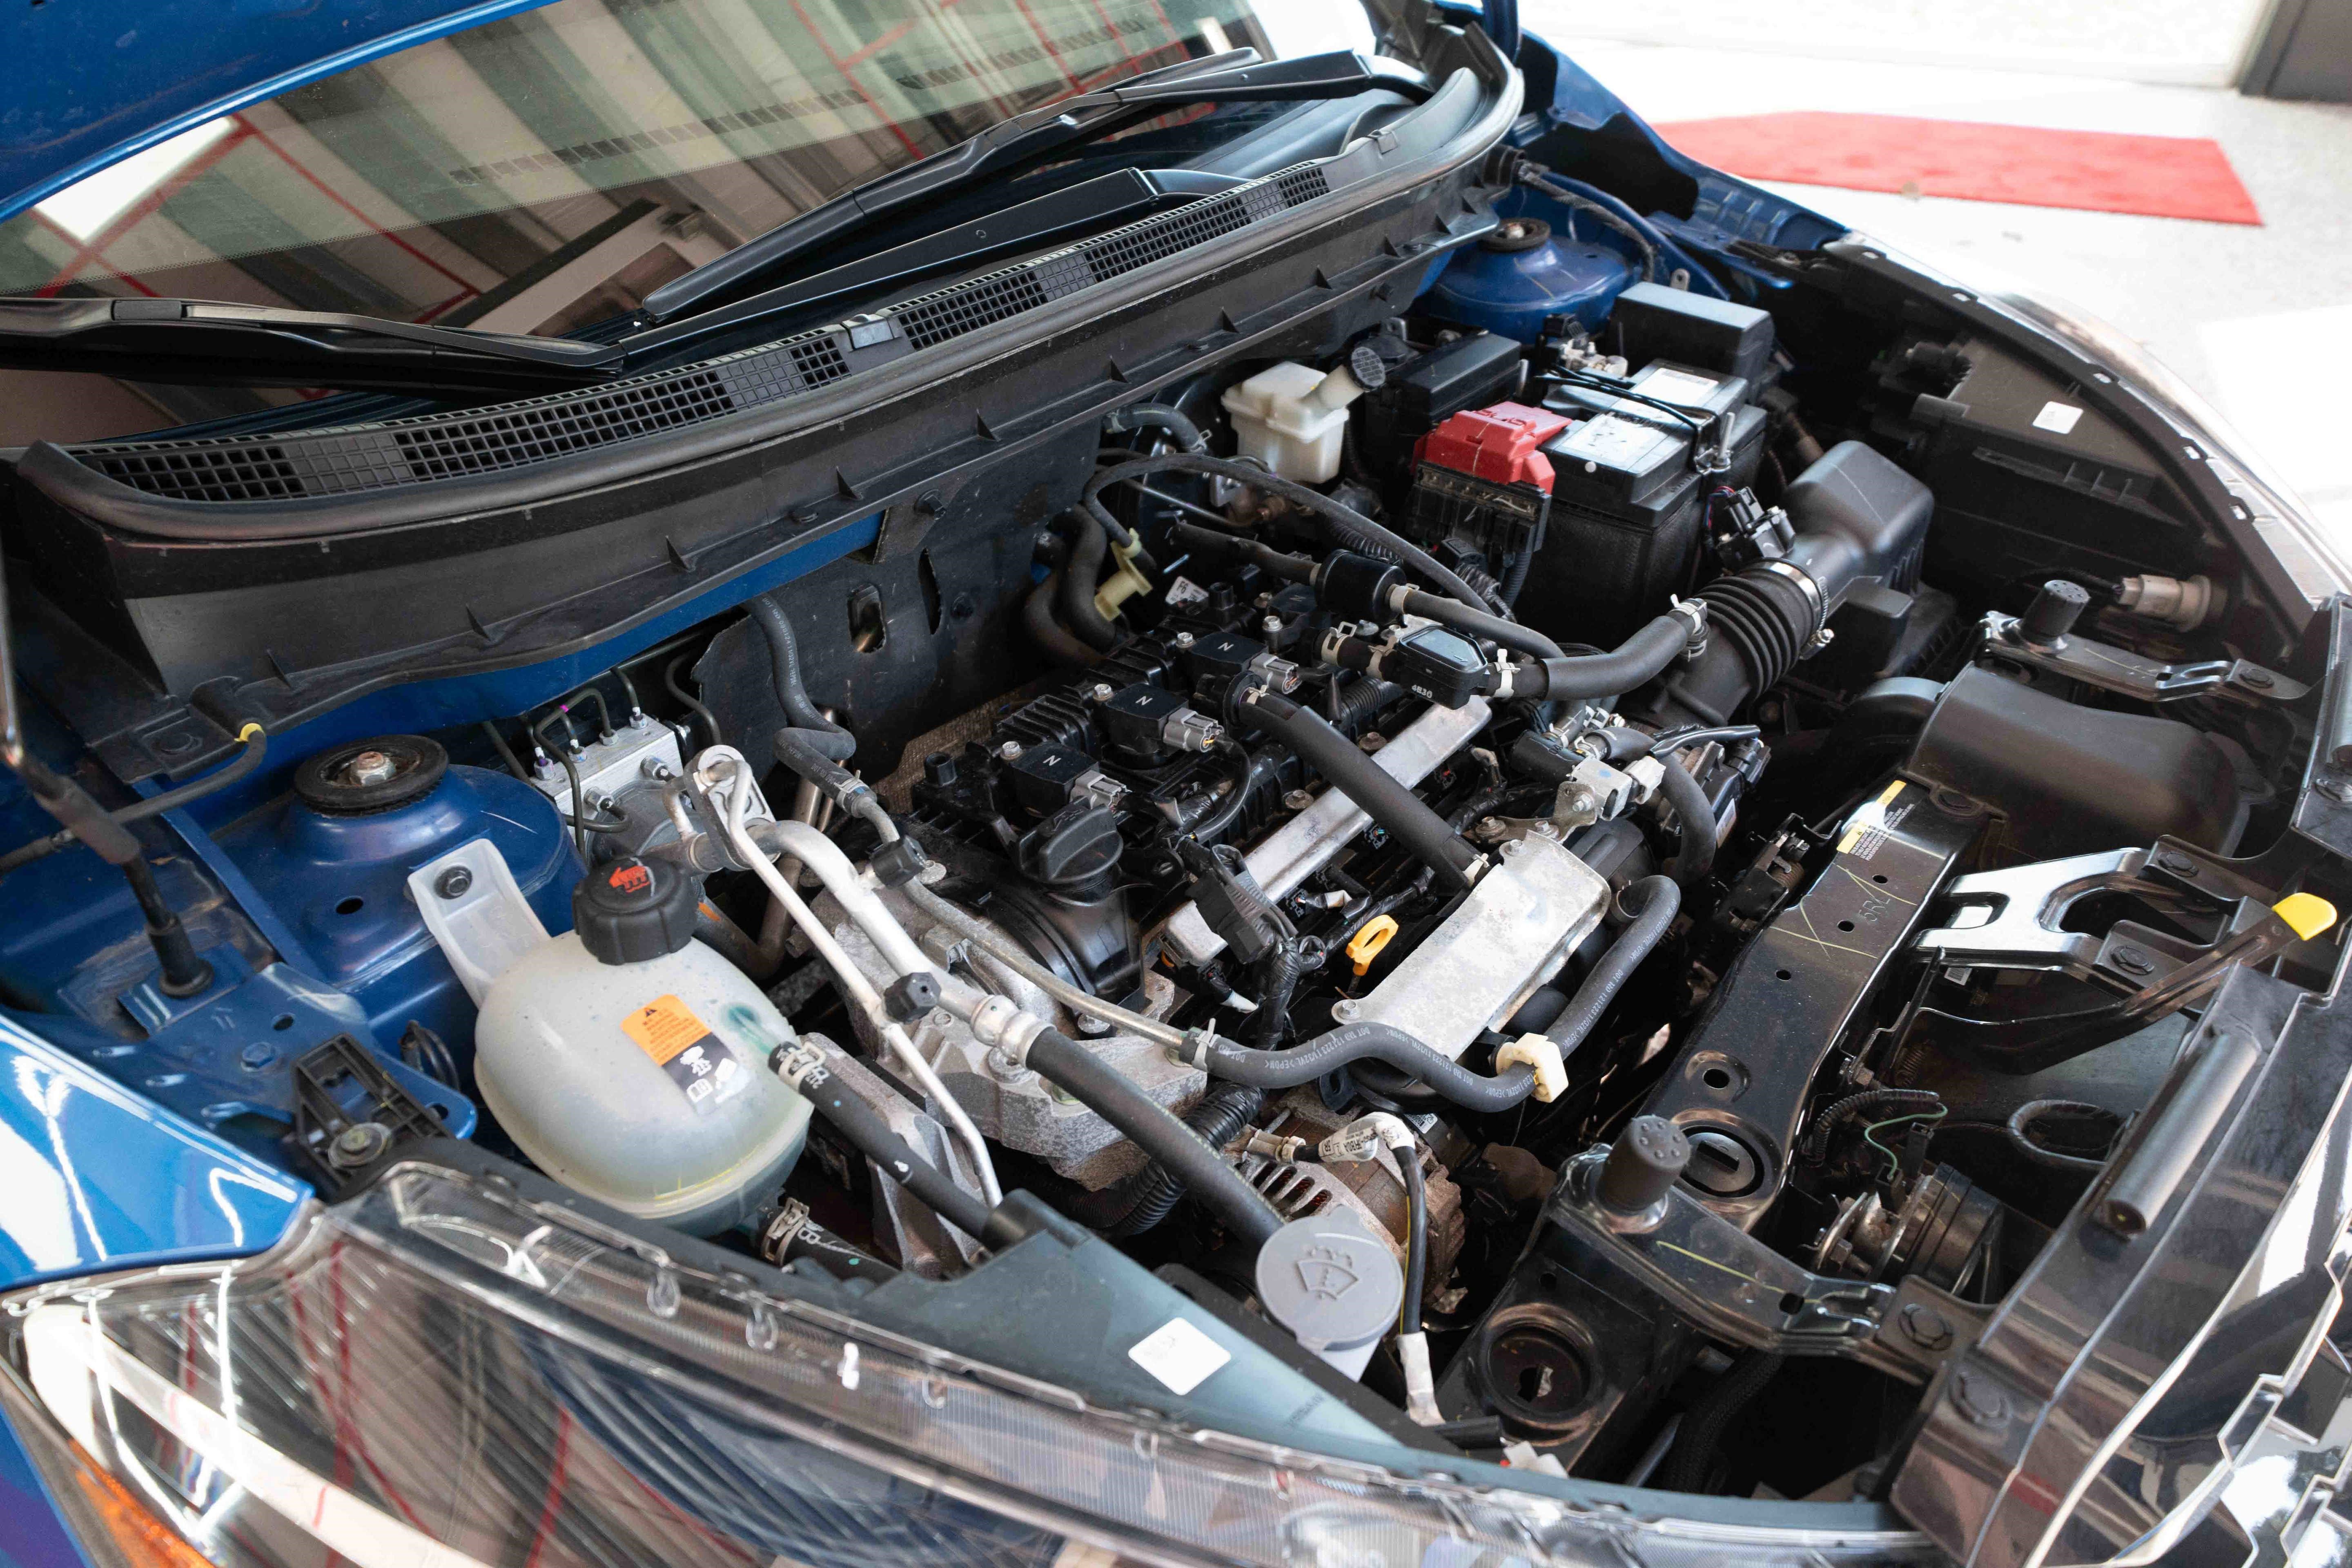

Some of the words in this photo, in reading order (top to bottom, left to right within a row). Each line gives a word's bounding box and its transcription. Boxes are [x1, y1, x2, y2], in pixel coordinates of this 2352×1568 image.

[1217, 642, 1235, 651] N
[1136, 696, 1153, 705] N
[1042, 755, 1061, 766] N
